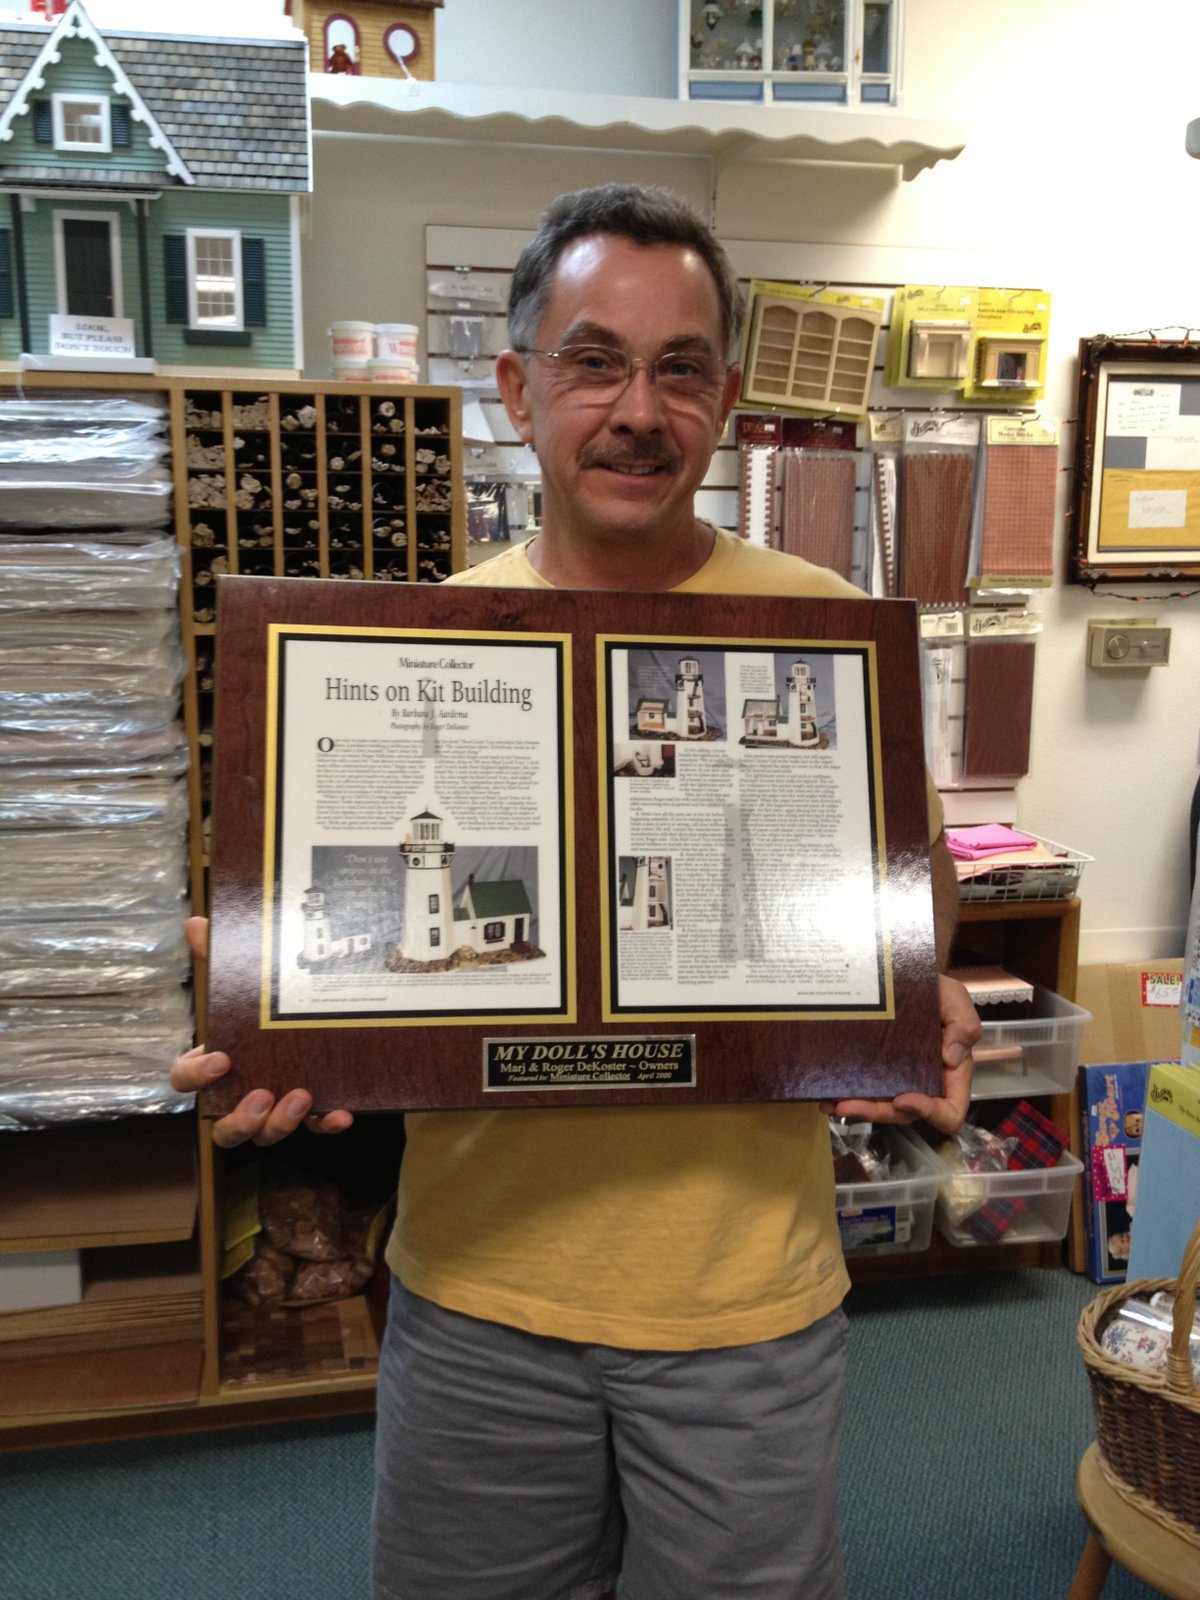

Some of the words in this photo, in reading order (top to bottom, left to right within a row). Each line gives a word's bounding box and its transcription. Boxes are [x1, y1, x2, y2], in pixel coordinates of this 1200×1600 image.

[399, 657, 439, 669] Miniature
[439, 658, 474, 670] Collector
[325, 677, 379, 701] Hints
[385, 683, 410, 701] on
[417, 678, 445, 702] Kit
[451, 679, 532, 712] Building
[391, 708, 400, 720] By
[402, 708, 430, 719] Barbara
[438, 709, 469, 719] Aardema
[1149, 975, 1179, 985] SALE!
[494, 1045, 530, 1061] MY
[532, 1044, 606, 1060] DOLL'S
[612, 1042, 684, 1058] HOUSE
[500, 1062, 526, 1073] Marj
[528, 1062, 539, 1072] &
[542, 1062, 573, 1074] Roger
[576, 1061, 626, 1072] DeKoster
[638, 1060, 679, 1071] Owners
[508, 1074, 538, 1082] Featured
[550, 1073, 591, 1082] Miniature
[592, 1072, 631, 1081] Collector
[637, 1072, 655, 1081] April
